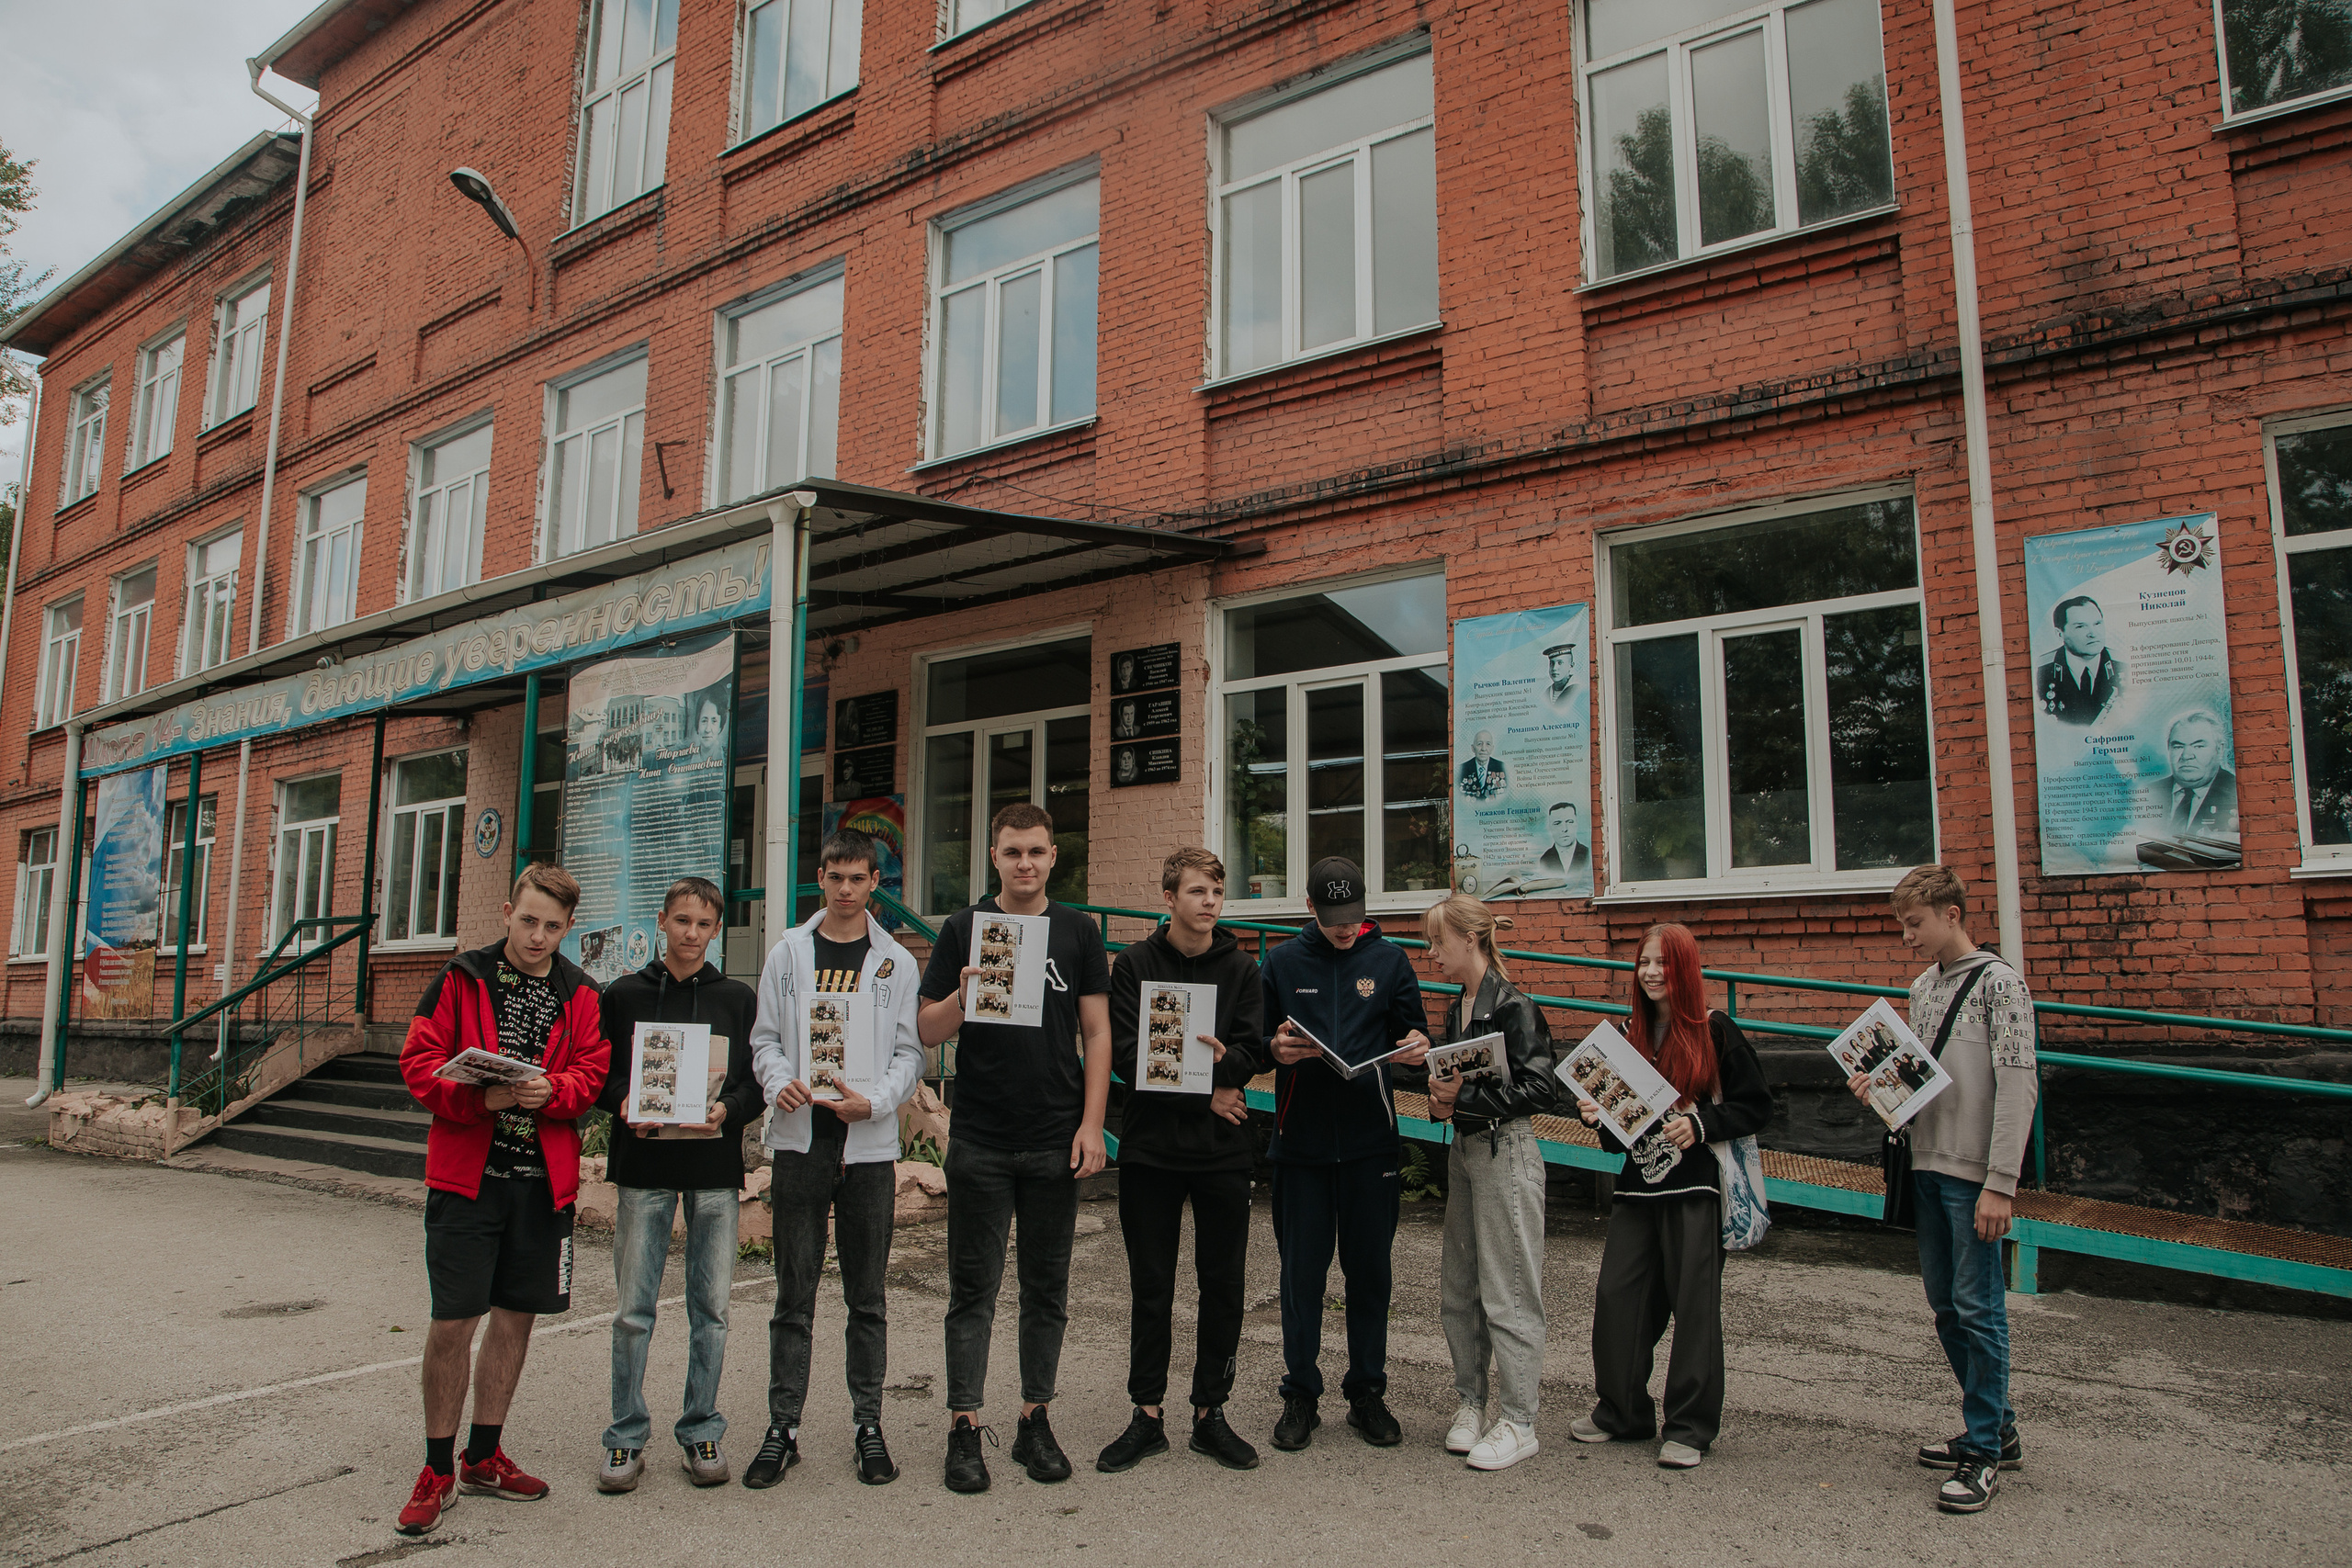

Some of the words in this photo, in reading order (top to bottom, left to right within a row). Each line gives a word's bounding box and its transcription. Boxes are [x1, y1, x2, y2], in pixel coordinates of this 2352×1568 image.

[2139, 589, 2186, 601] Кузнецов
[2141, 599, 2186, 611] Николай
[2128, 619, 2168, 628] Выпускник
[2140, 640, 2189, 651] форсирование
[2191, 637, 2221, 647] Днепра,
[79, 731, 146, 770] Школа
[187, 690, 292, 742] Знания,
[301, 652, 435, 715] дающие
[439, 542, 770, 690] уверенность!
[2131, 651, 2170, 660] подавление
[2132, 660, 2172, 669] противника
[2132, 668, 2168, 677] присвоено
[2154, 674, 2194, 682] Советского
[1474, 682, 1500, 690] Рычков
[1502, 678, 1536, 687] Валентин
[1508, 726, 1539, 734] Ромашко
[1542, 722, 1579, 731] Александр
[2084, 734, 2135, 745] Сафронов
[2092, 746, 2128, 756] Герман
[2043, 775, 2081, 784] Профессор
[2083, 771, 2161, 781] Санкт-Петербургского
[1507, 807, 1541, 815] Геннадий
[2052, 807, 2080, 816] феврале
[2100, 814, 2132, 822] получает
